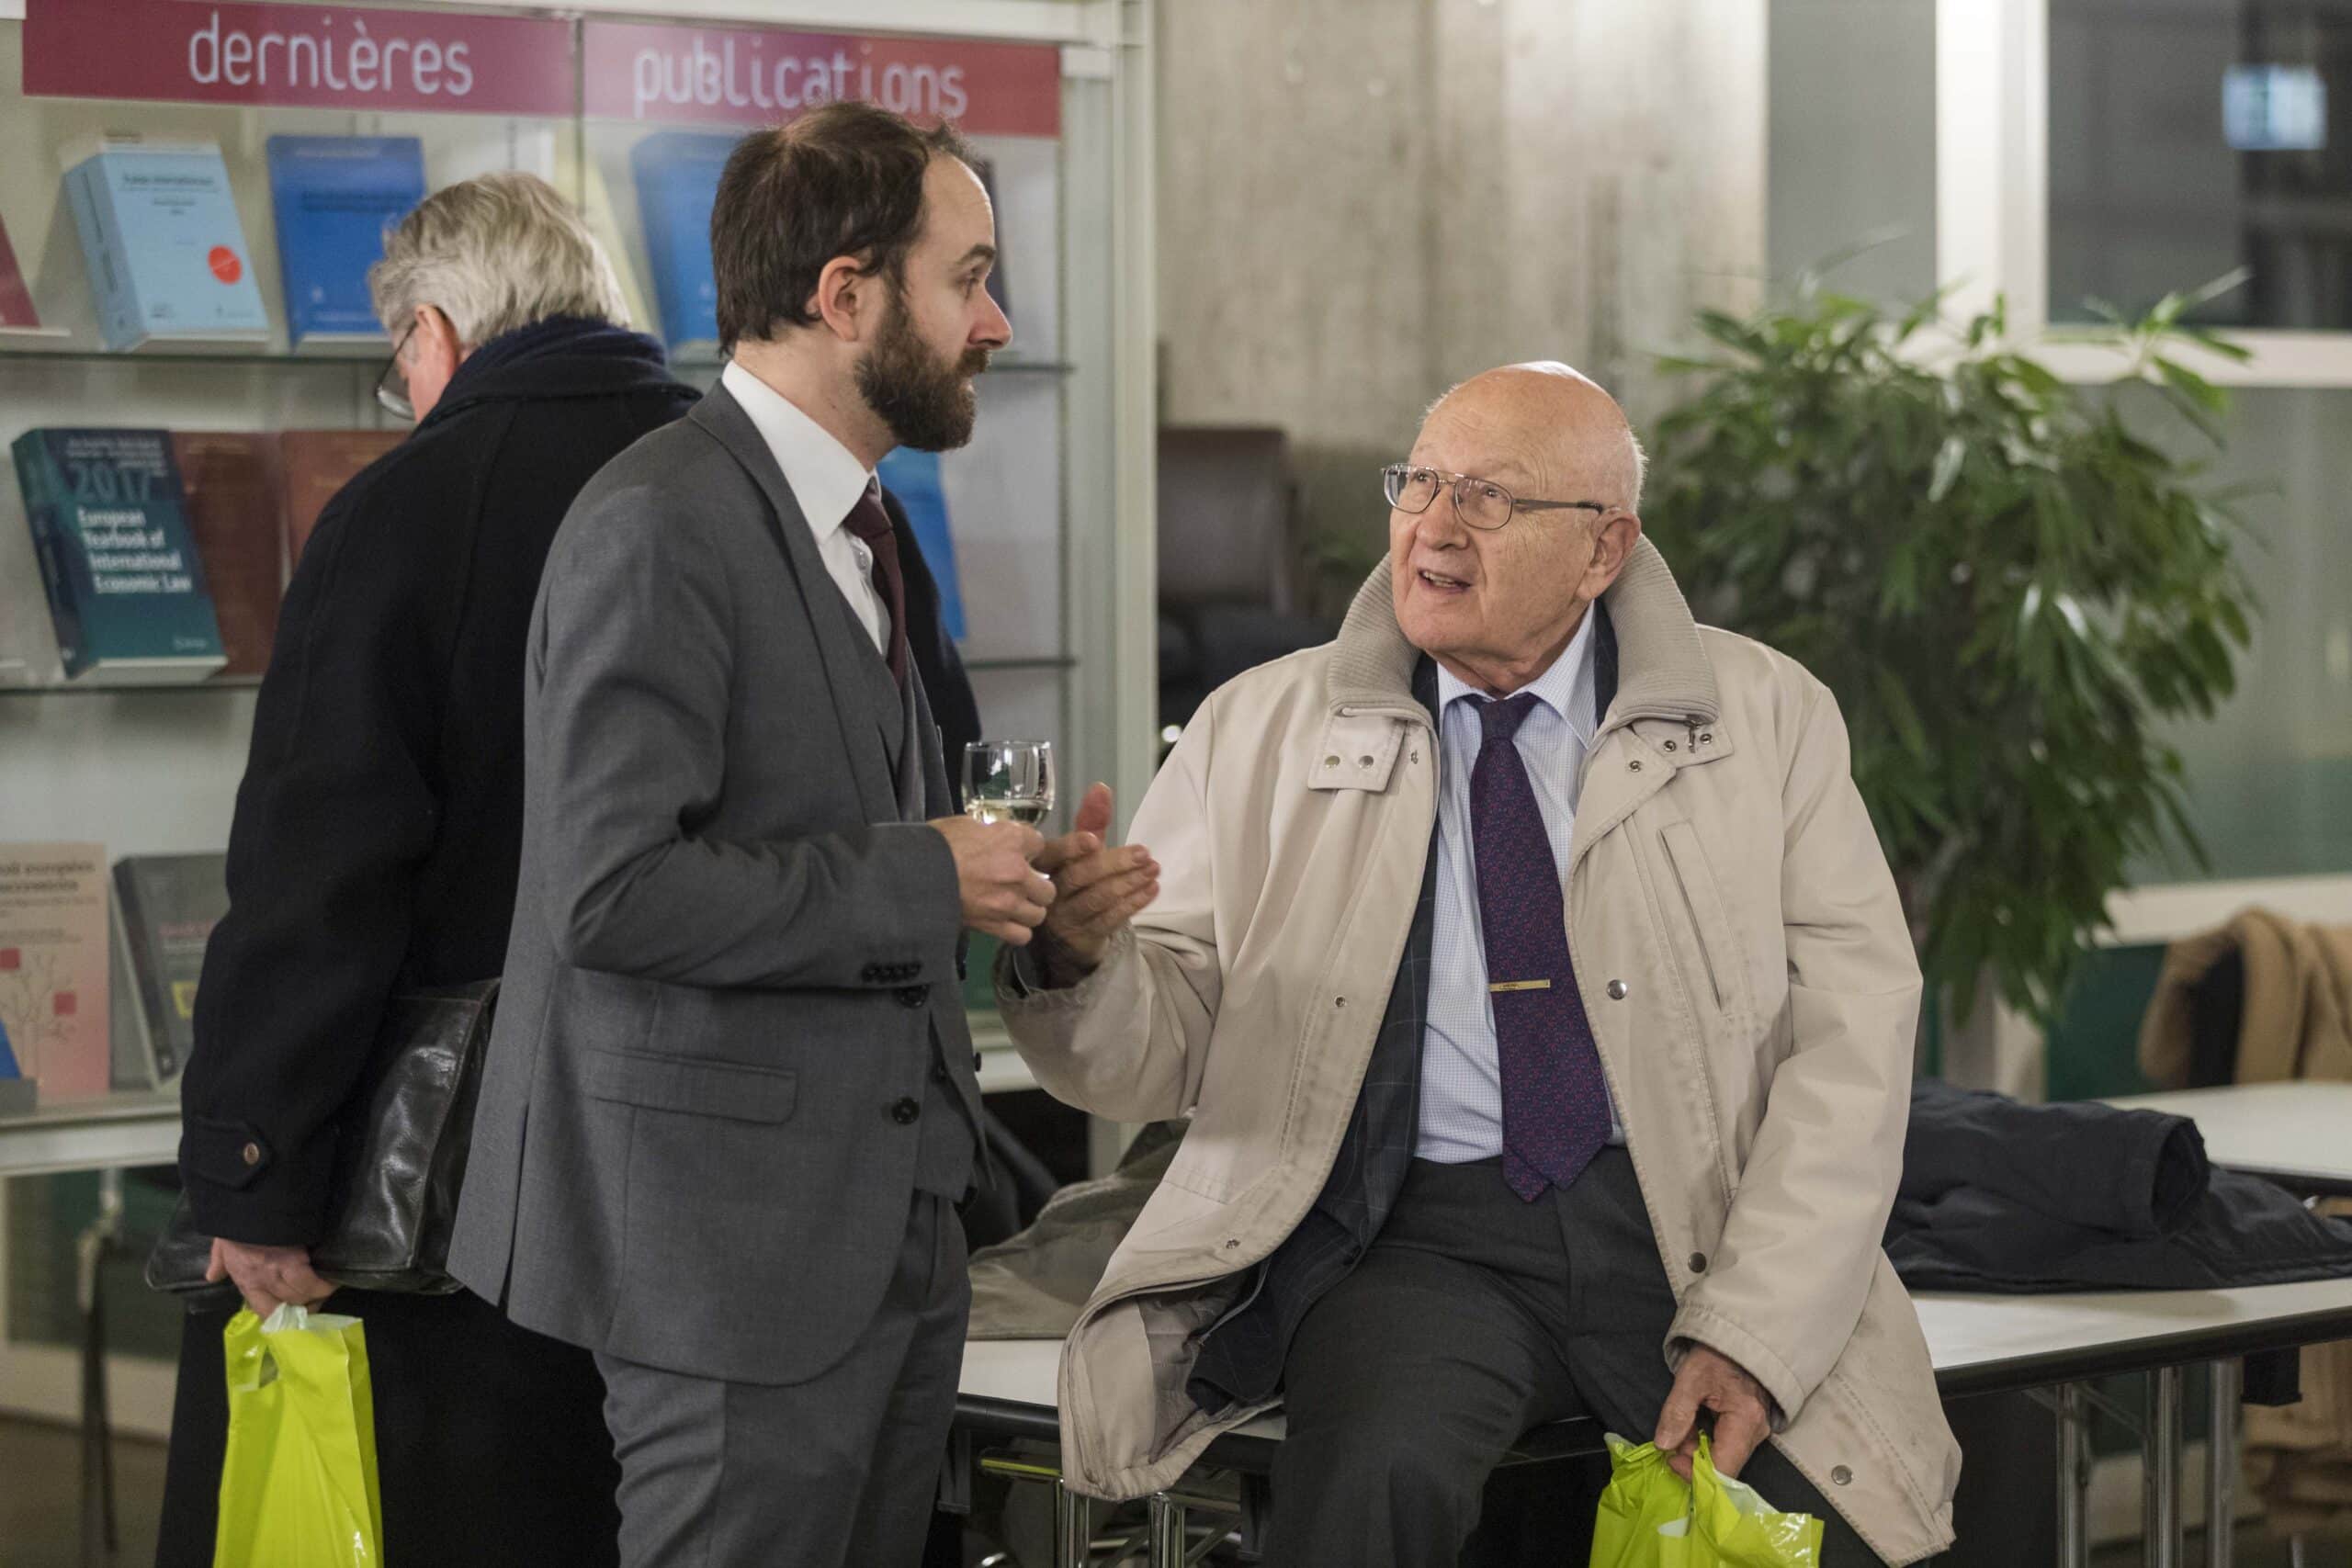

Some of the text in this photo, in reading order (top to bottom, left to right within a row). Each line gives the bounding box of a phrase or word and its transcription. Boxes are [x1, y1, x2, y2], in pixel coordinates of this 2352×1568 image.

[189, 12, 967, 119] dernières publications
[69, 462, 152, 502] 2017
[77, 507, 146, 532] European
[83, 528, 165, 548] Yearbook of
[88, 551, 183, 571] International
[95, 573, 192, 594] Economic Law
